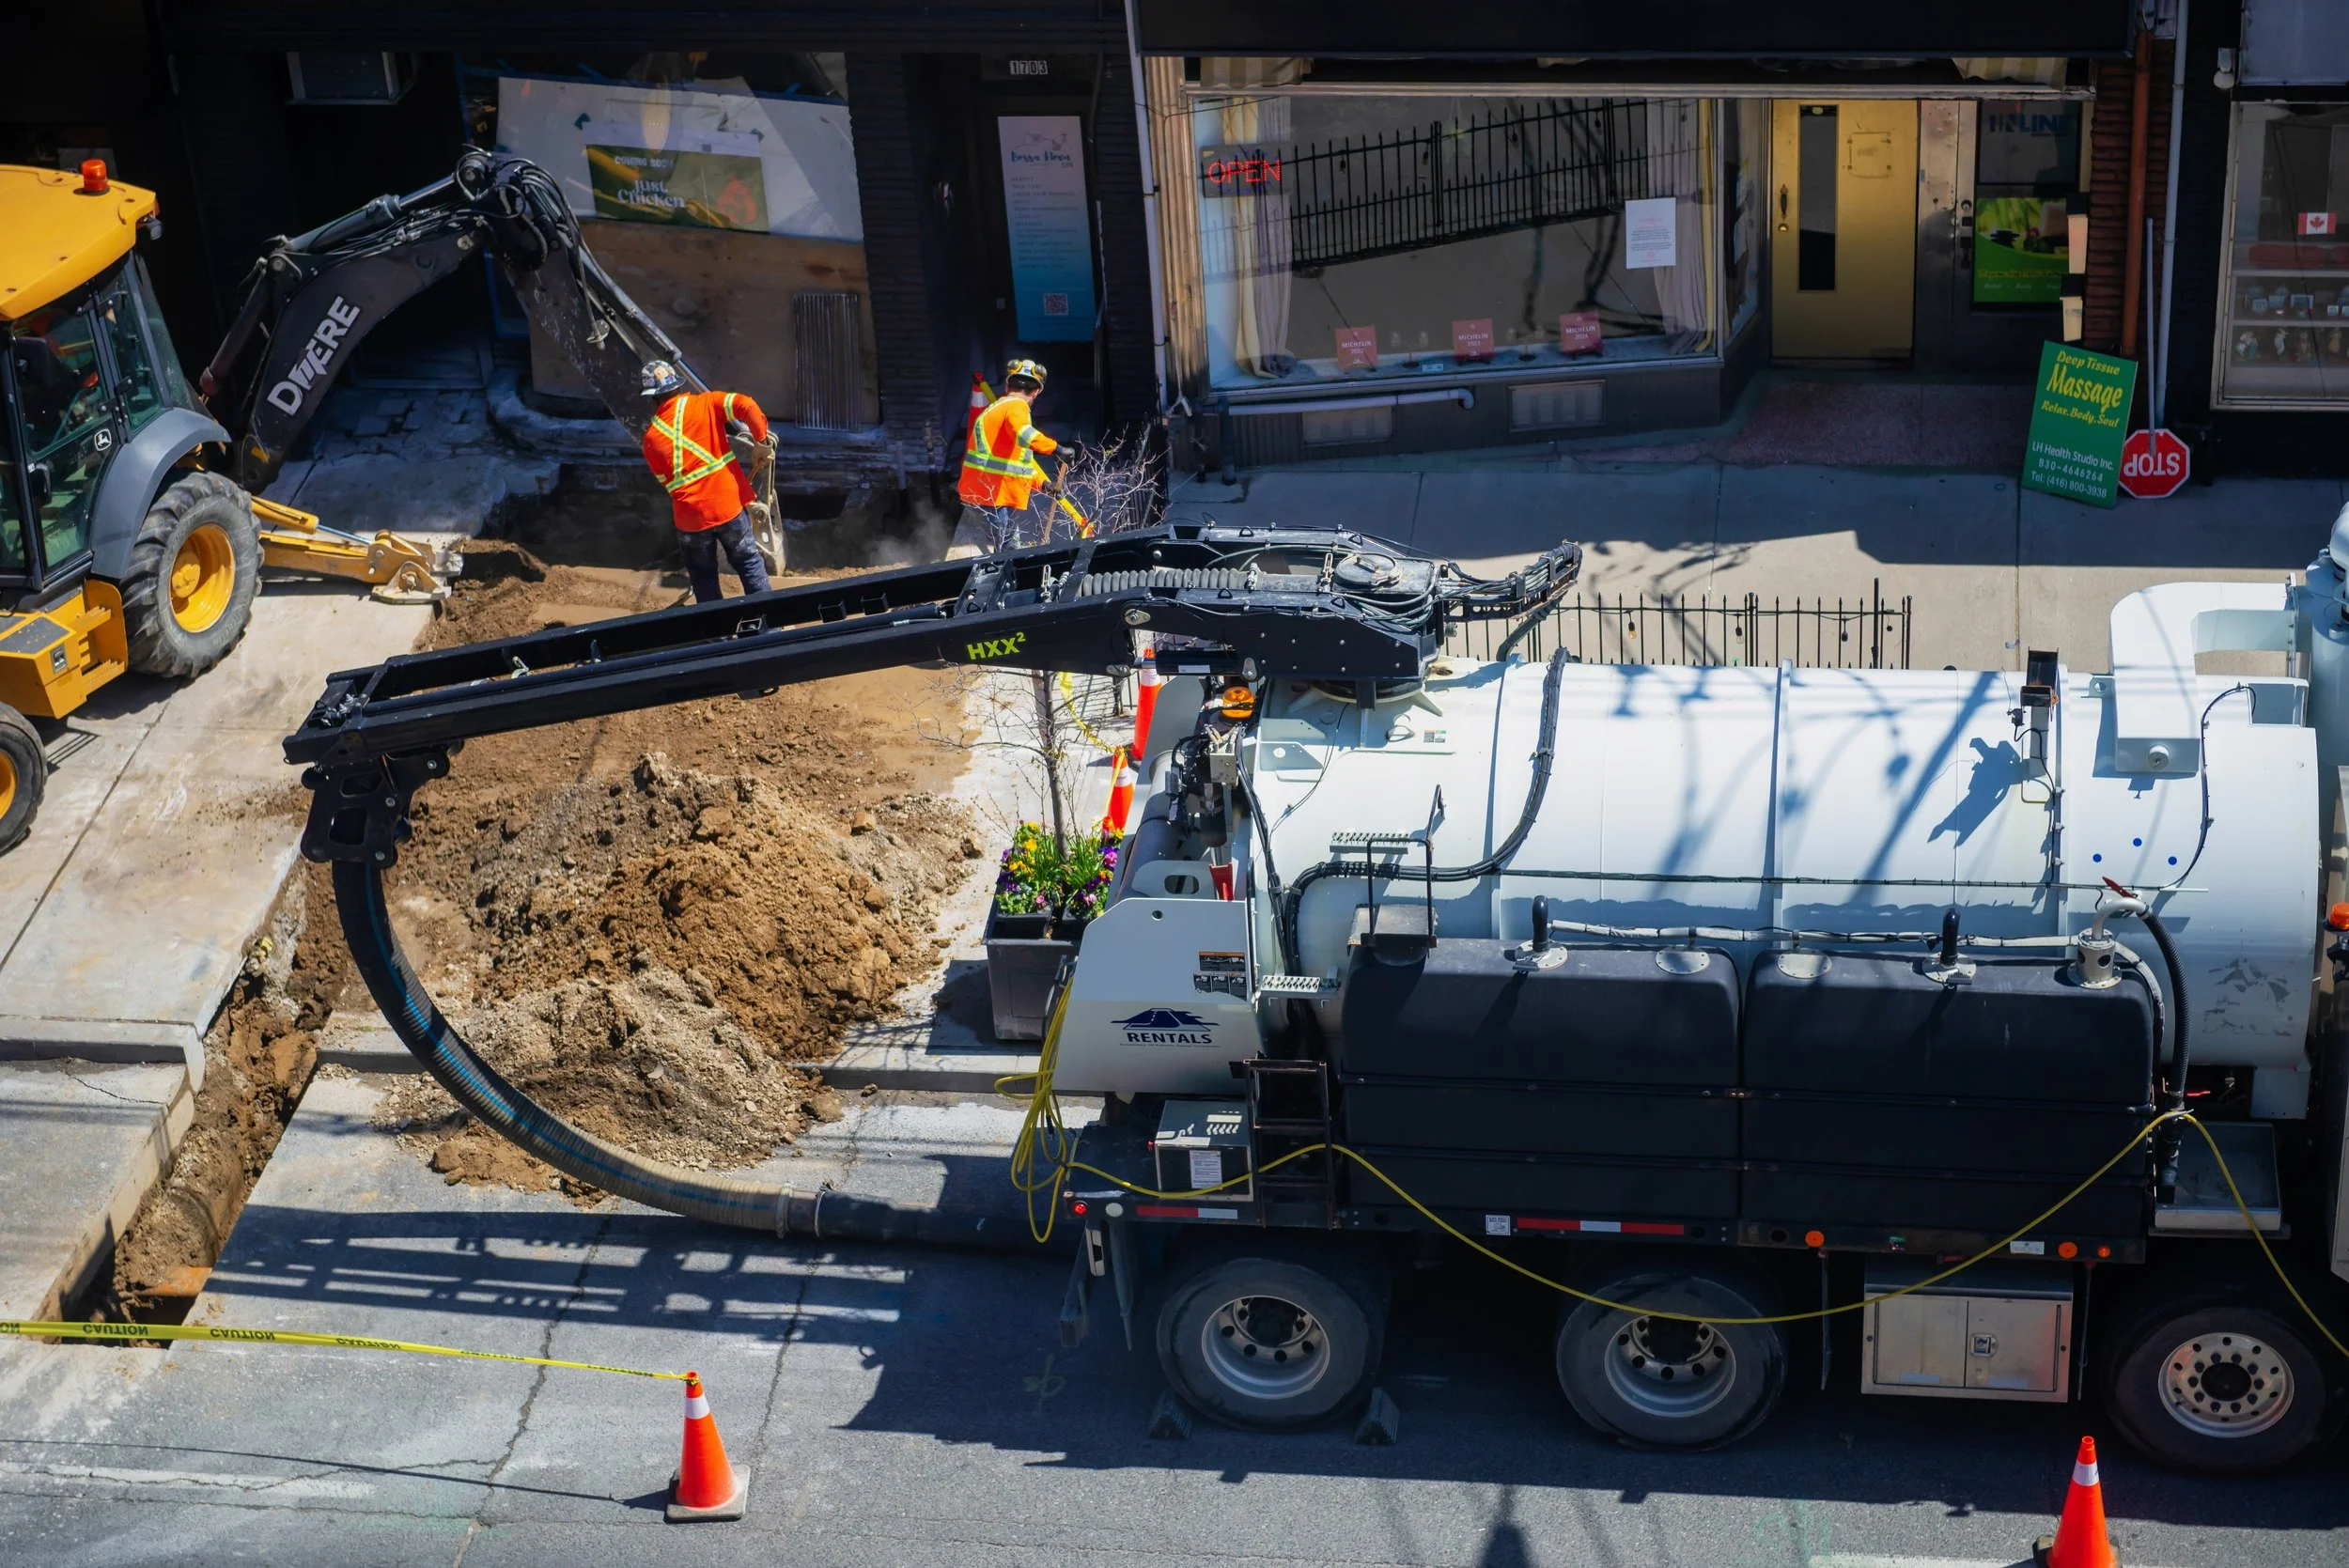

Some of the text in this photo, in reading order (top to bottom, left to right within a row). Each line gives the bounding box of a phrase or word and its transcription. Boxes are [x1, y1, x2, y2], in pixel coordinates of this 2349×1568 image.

[1010, 60, 1048, 75] 1703
[1207, 160, 1281, 185] OPEN
[1565, 325, 1596, 334] MICHELIN
[1342, 340, 1372, 349] MICHELIN
[2056, 350, 2121, 376] Deep Tissue
[2046, 363, 2123, 414] Massage
[2031, 441, 2114, 471] LH Health Studio Inc.
[2123, 452, 2181, 477] STOP
[2030, 471, 2046, 484] Tel:
[2046, 474, 2068, 489] (416)
[1127, 1032, 1212, 1044] RENTALS
